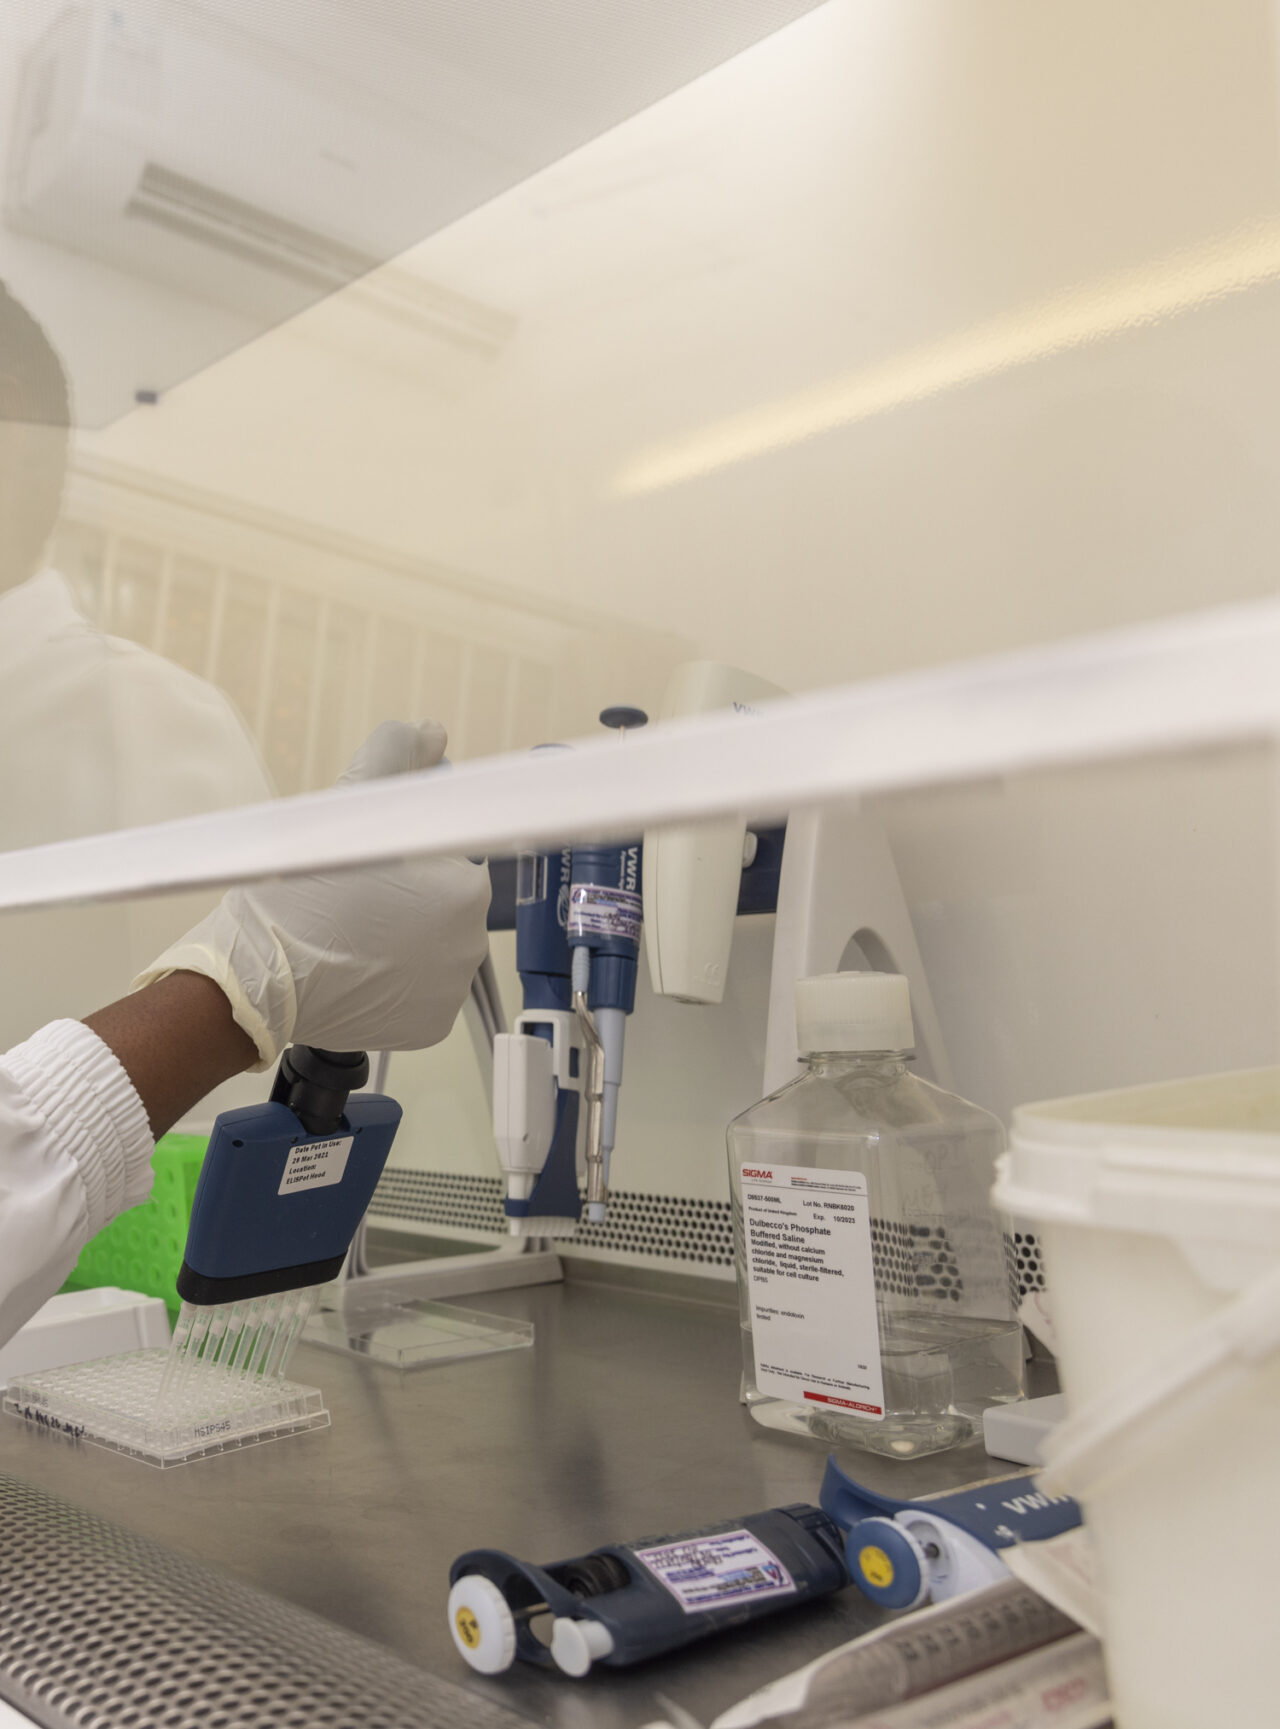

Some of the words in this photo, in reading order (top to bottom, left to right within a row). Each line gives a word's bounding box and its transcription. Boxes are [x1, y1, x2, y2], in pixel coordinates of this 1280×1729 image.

[626, 847, 638, 891] VWR
[295, 1146, 309, 1154] Date
[301, 1155, 312, 1163] Mar
[742, 1168, 773, 1180] SIGMA
[813, 1200, 822, 1208] No.
[813, 1213, 825, 1221] Exp.
[833, 1215, 856, 1224] 10/2023
[749, 1218, 789, 1231] Dulbecco's
[790, 1223, 832, 1236] Phosphate
[750, 1229, 781, 1241] Buffered
[782, 1233, 806, 1244] Saline
[751, 1239, 778, 1249] Modified,
[778, 1243, 800, 1252] without
[801, 1246, 826, 1255] calcium
[751, 1248, 775, 1257] chloride
[775, 1251, 787, 1259] and
[788, 1253, 824, 1264] magnesium
[752, 1257, 777, 1267] chloride,
[779, 1261, 798, 1271] liquid,
[799, 1264, 845, 1277] sterile-filtered,
[753, 1266, 776, 1275] suitable
[786, 1270, 797, 1278] cell
[797, 1273, 820, 1282] culture
